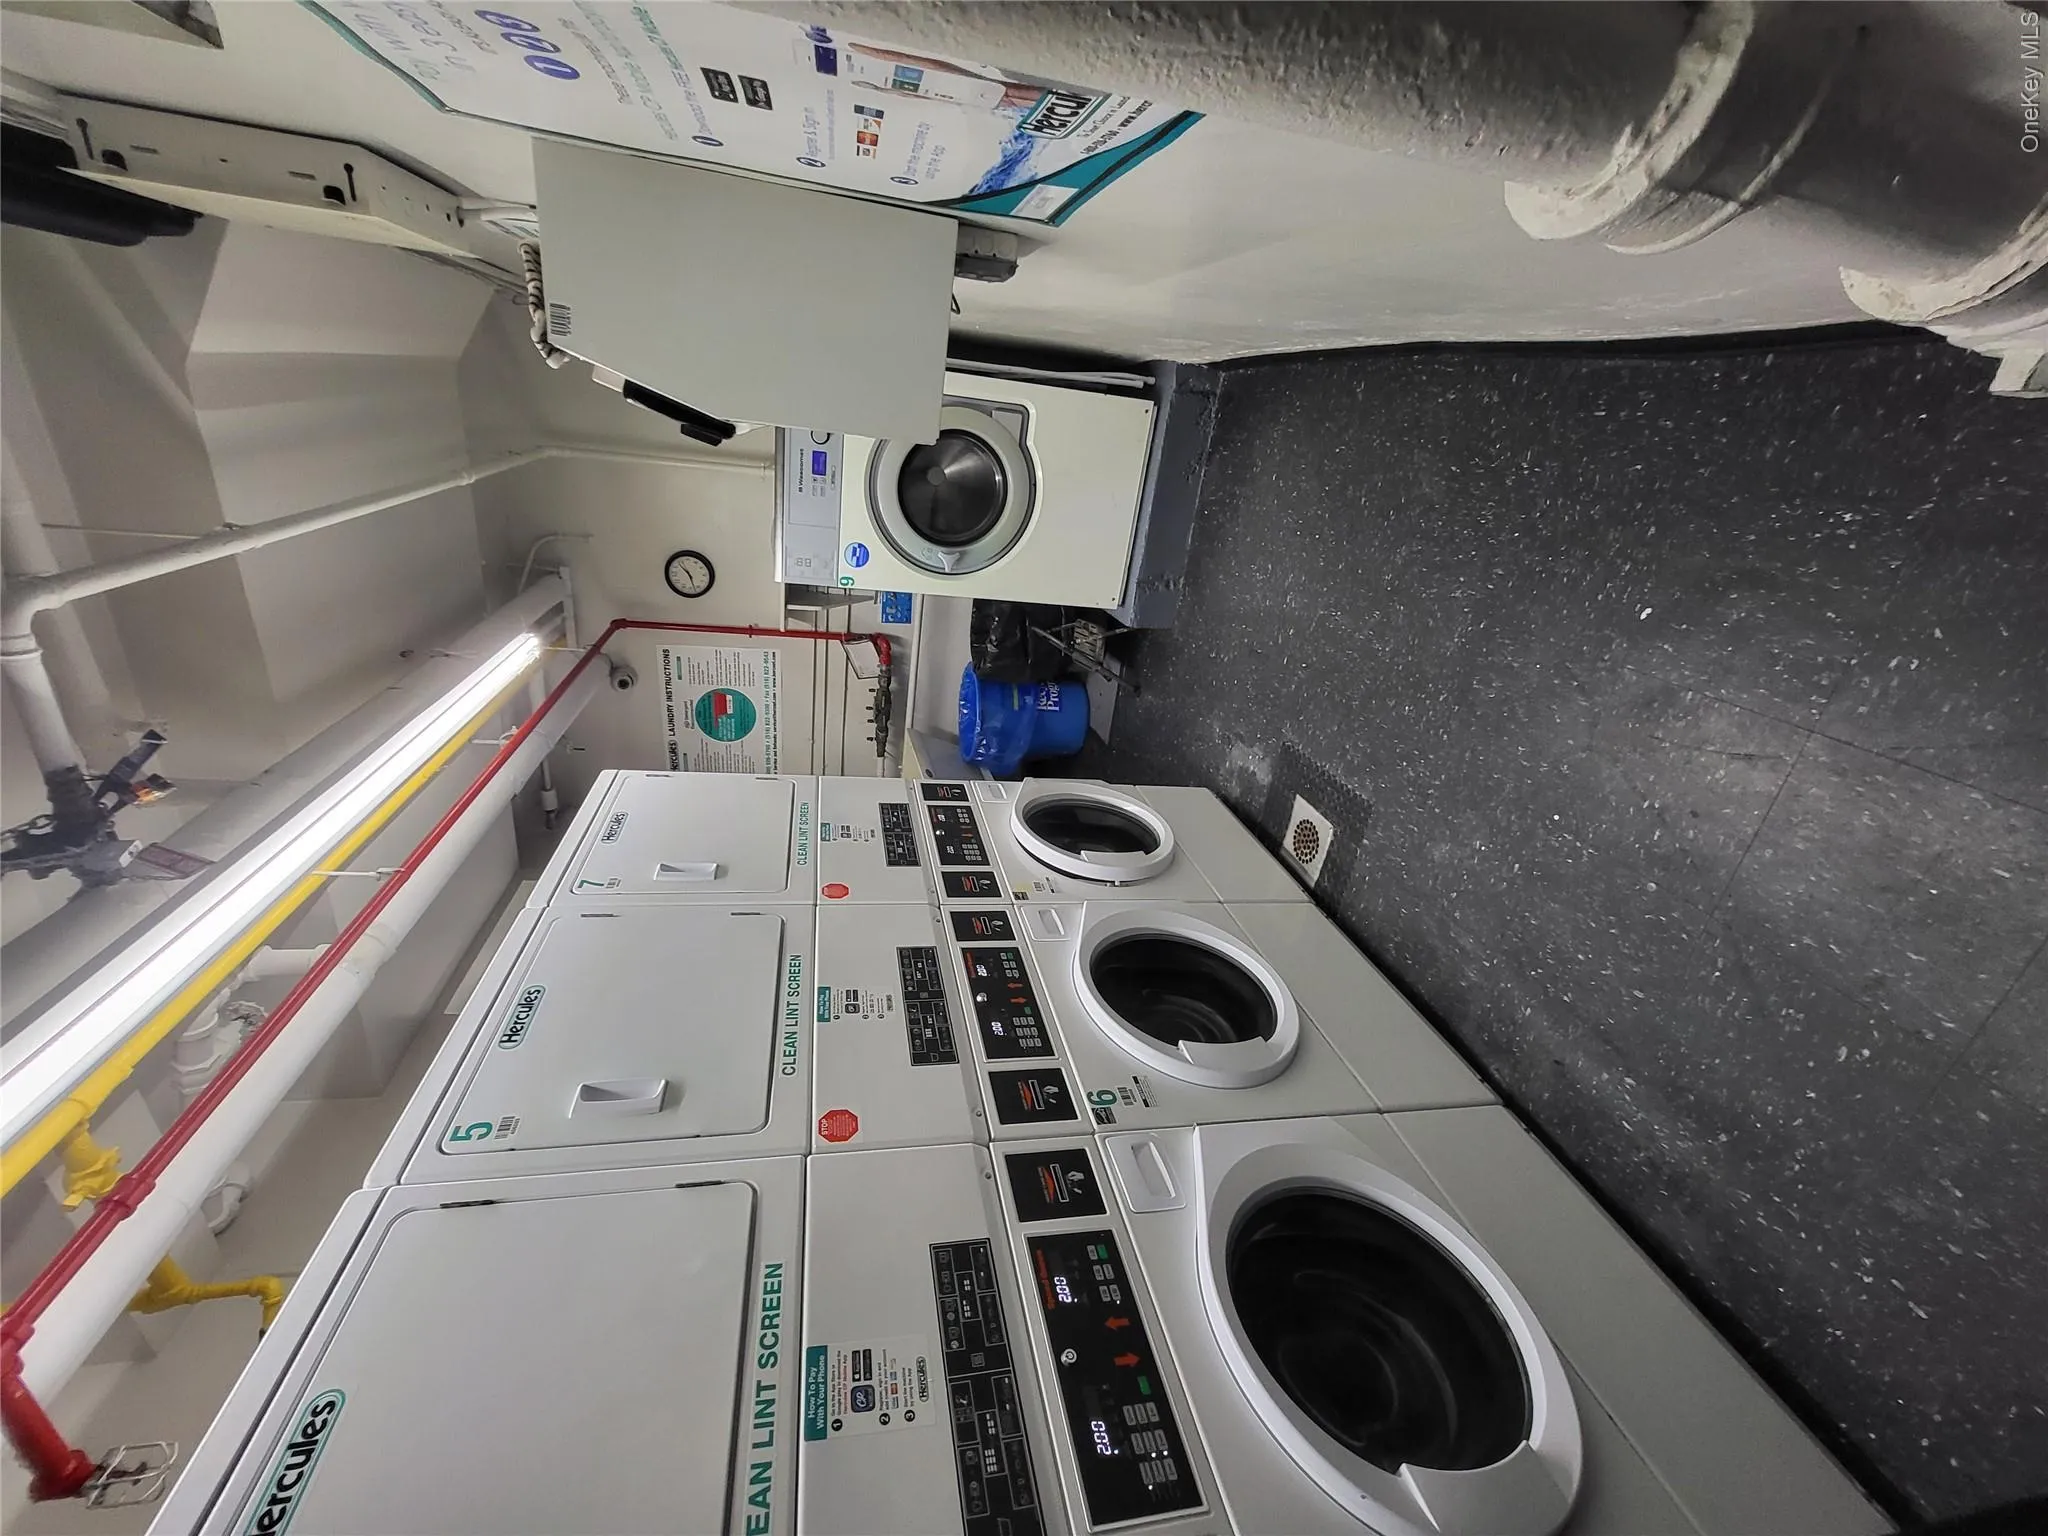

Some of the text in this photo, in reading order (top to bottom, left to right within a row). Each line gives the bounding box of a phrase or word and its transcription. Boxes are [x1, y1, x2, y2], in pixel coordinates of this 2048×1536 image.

[484, 14, 531, 29] 3
[511, 34, 554, 48] 2
[1023, 90, 1092, 135] Hercul
[839, 576, 855, 587] 9
[662, 649, 673, 703] INSTRUCTIONS
[666, 704, 676, 737] LAUNDRY
[600, 813, 626, 841] Hercules
[797, 802, 810, 866] CLEAN LINT SCREEN
[577, 879, 605, 889] 7
[499, 989, 542, 1044] Hercules
[781, 953, 802, 1077] CLEAN LINT SCREEN
[1087, 1089, 1117, 1106] 6
[449, 1122, 493, 1142] 5
[1054, 1277, 1072, 1303] 2.00
[757, 1262, 785, 1370] SCREEN
[809, 1367, 817, 1382] Pay
[917, 1359, 927, 1398] Hercules
[809, 1384, 815, 1395] To
[817, 1384, 825, 1405] Your
[752, 1379, 778, 1450] LINT
[1091, 1420, 1112, 1456] 2.00
